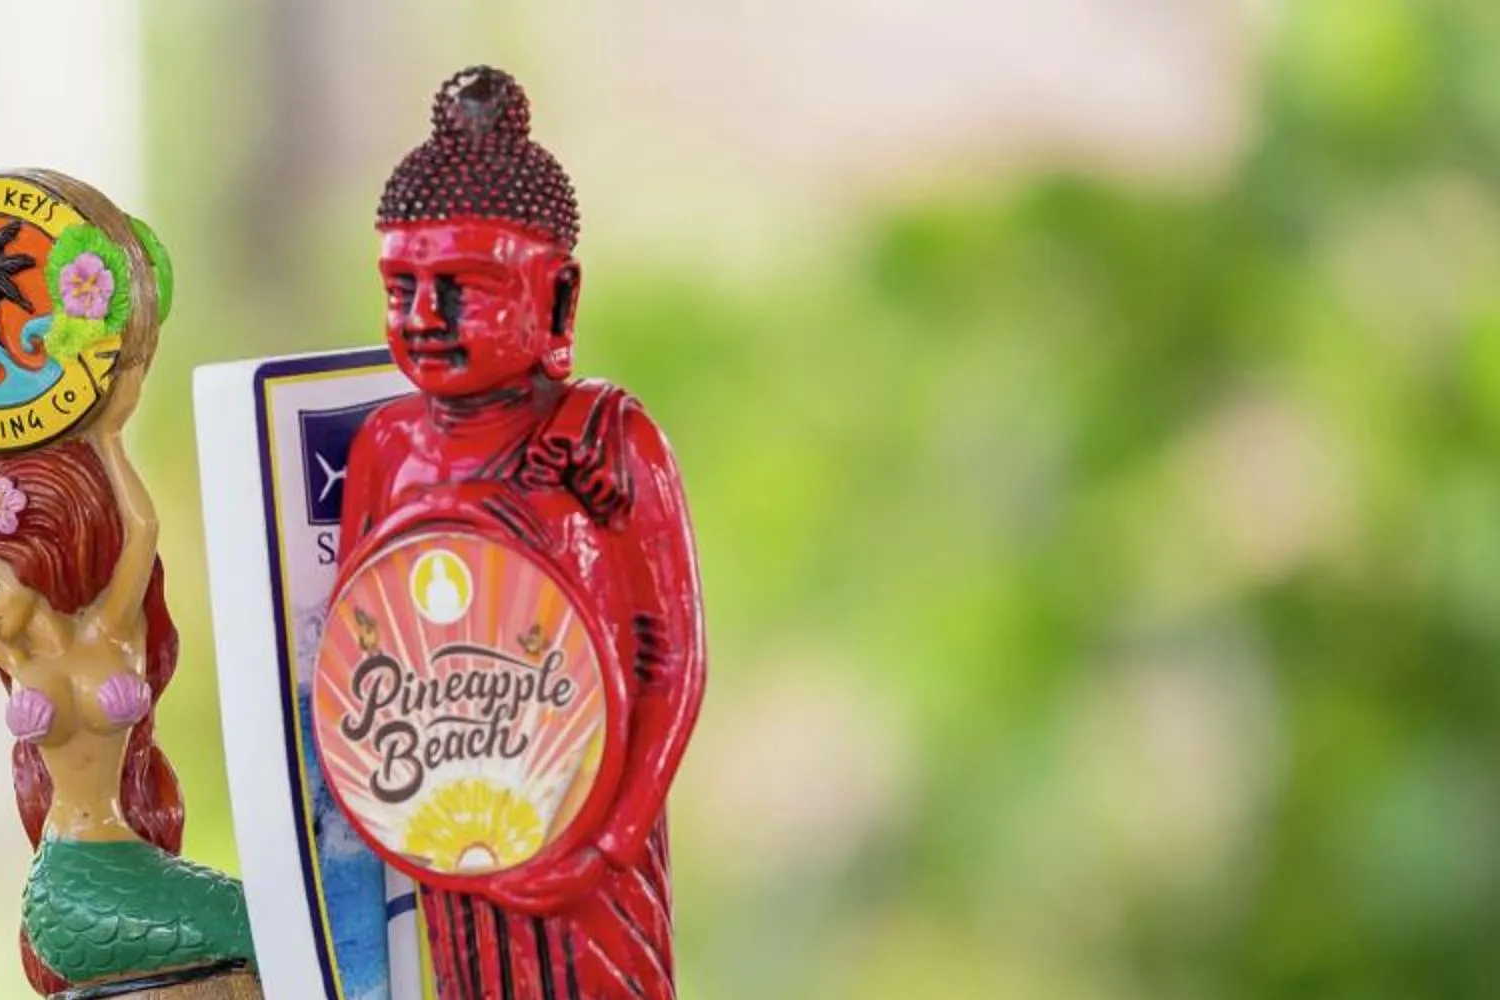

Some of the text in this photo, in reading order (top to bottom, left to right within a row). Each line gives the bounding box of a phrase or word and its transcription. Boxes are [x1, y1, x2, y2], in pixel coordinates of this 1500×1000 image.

[4, 187, 59, 222] KEYS
[341, 645, 573, 741] Pineapple
[370, 704, 528, 804] Beach
